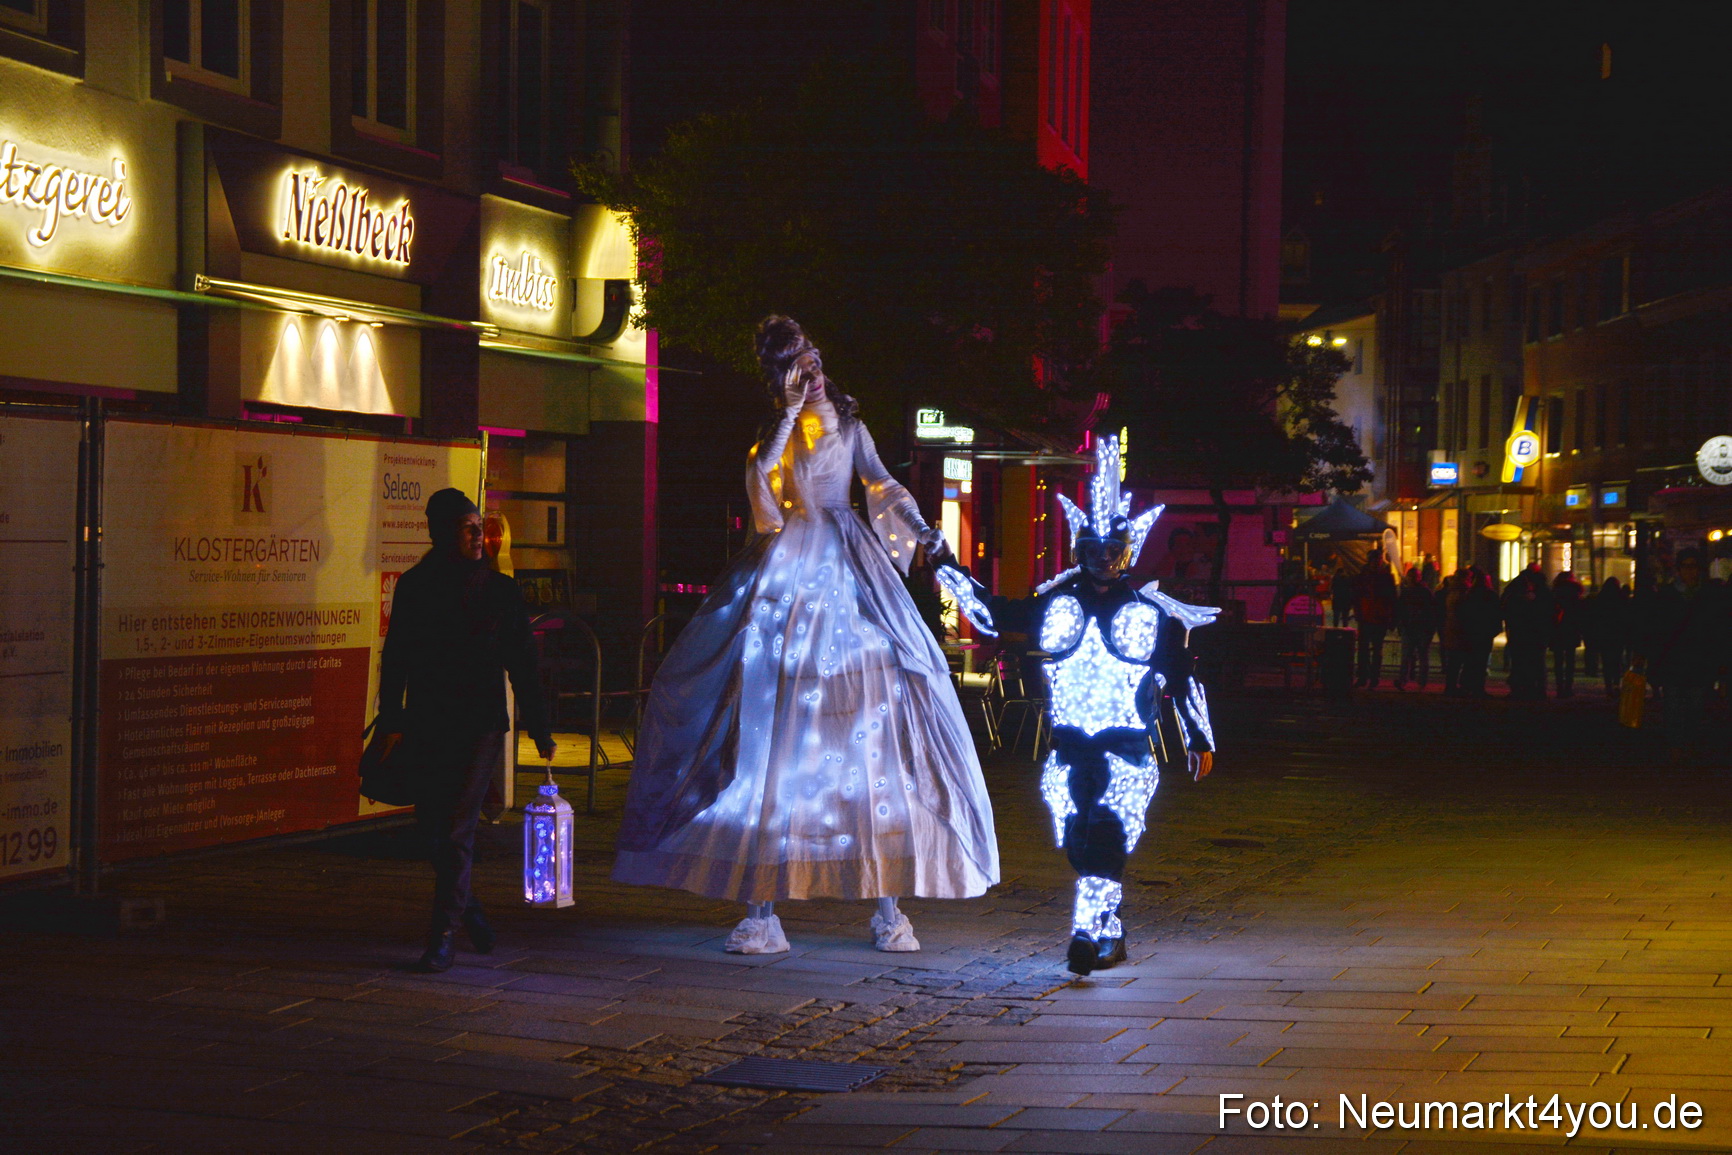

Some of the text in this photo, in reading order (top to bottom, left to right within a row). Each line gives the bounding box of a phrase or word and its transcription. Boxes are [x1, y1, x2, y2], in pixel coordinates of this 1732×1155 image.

[283, 170, 415, 264] Nießlbeck
[492, 253, 557, 308] Imbiss
[1517, 441, 1532, 455] B
[383, 453, 437, 469] Projektentwicklung:
[383, 472, 421, 500] Seleco
[382, 519, 428, 531] www.seleco-gmb
[174, 535, 321, 562] KLOSTERGÄRTEN
[189, 569, 307, 585] Service-Wohnen für Senioren
[118, 609, 361, 632] Hier entstehen SENIORENWOHNUNGEN
[175, 636, 194, 650] und
[197, 632, 347, 649] 3-Zimmer-Eigentumswohnungen
[125, 667, 151, 680] Pflege
[153, 666, 167, 679] bei
[168, 665, 195, 678] Bedarf
[205, 664, 219, 675] der
[220, 664, 250, 677] eigenen
[252, 660, 285, 674] Wohnung
[286, 658, 306, 670] durch
[306, 657, 318, 669] die
[319, 656, 342, 669] Caritas
[137, 686, 171, 700] Stunden
[173, 683, 213, 697] Sicherheit
[124, 696, 312, 721] Umfassendes Dienstleistungs- und Serviceangebot
[124, 713, 315, 741] Hotelähnliches Flair mit Rezeption und großzügigen
[123, 741, 210, 759] Gemeinschaftsräumen
[162, 763, 174, 775] bis
[176, 763, 188, 774] ca.
[214, 754, 258, 769] Wohnfläche
[157, 781, 202, 796] Wohnungen
[204, 778, 218, 789] mit
[218, 774, 246, 791] Loggia,
[247, 770, 277, 784] Terrasse
[278, 769, 293, 781] oder
[294, 764, 337, 779] Dachterrasse
[122, 807, 142, 821] Kauf
[162, 801, 184, 815] Miete
[186, 797, 216, 814] möglich
[156, 821, 202, 838] Eigennutzer
[204, 818, 218, 830] und
